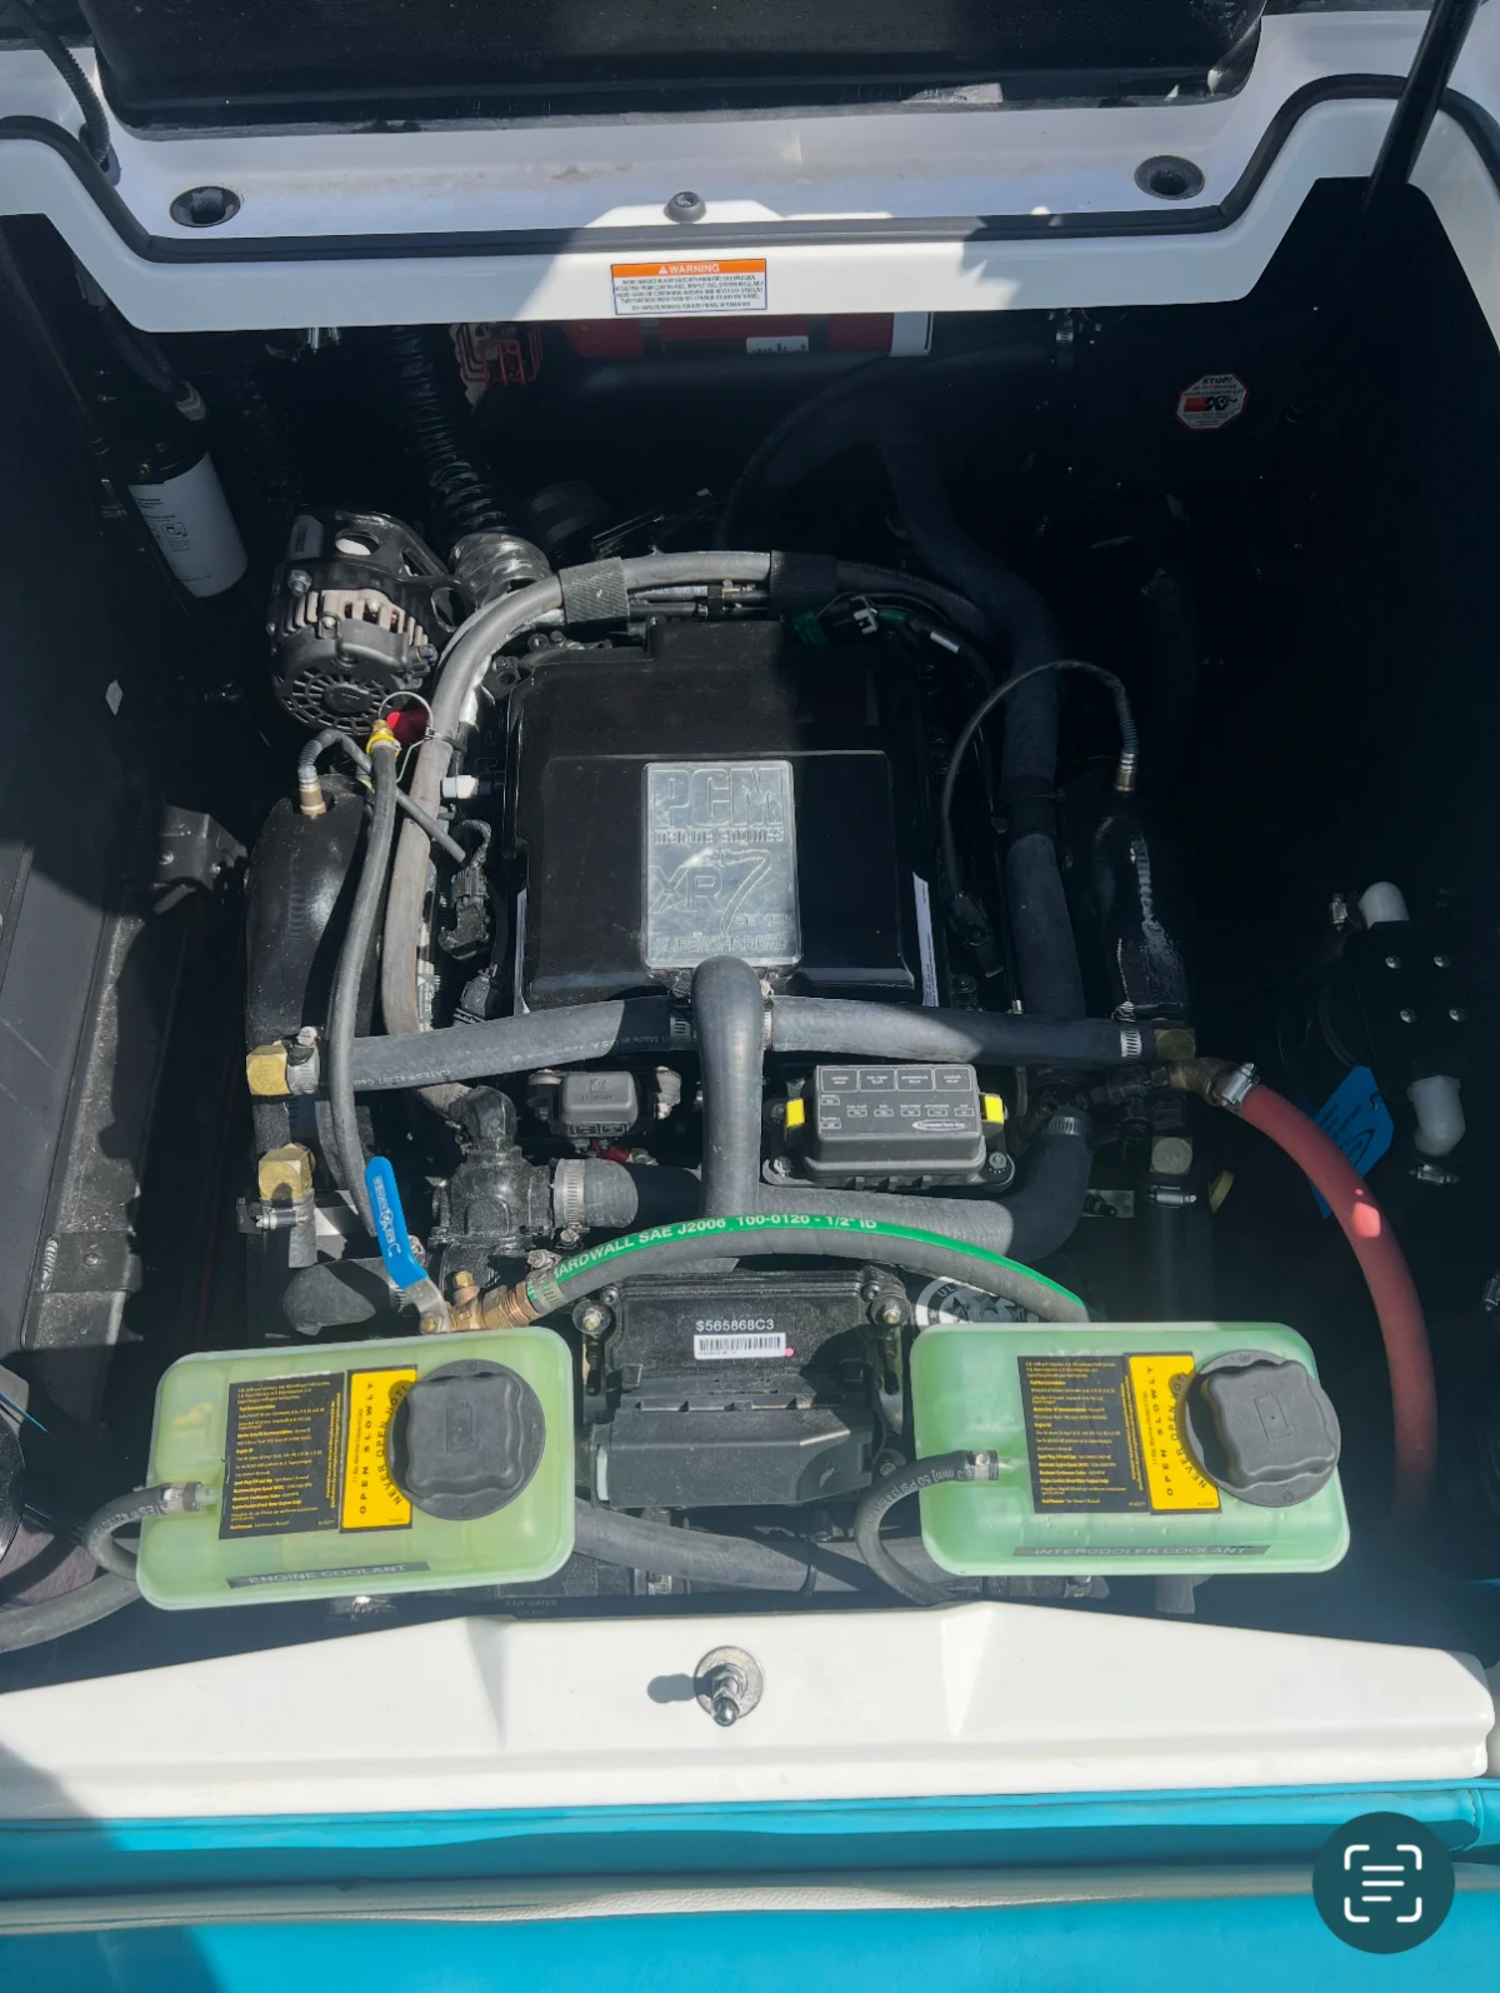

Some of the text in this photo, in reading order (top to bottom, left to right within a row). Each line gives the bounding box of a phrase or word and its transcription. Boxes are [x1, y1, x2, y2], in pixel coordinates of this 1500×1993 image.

[669, 264, 720, 274] WARNING
[652, 767, 786, 828] PCM
[654, 827, 785, 846] marine engines
[638, 1227, 673, 1244] SAE
[677, 1217, 727, 1235] J2006
[737, 1214, 810, 1227] 100-0120
[859, 1219, 877, 1230] ID
[376, 1421, 389, 1458] OPEN
[1146, 1366, 1173, 1496] OPEN SLOWLY
[1167, 1405, 1178, 1442] OPEN
[360, 1382, 374, 1515] OPEN SLOWLY
[377, 1464, 403, 1505] NEVER
[1176, 1447, 1207, 1489] NEVER
[1035, 1546, 1248, 1556] INTERCOOLER COOLANT
[249, 1564, 406, 1585] ENGINE COOLANT
